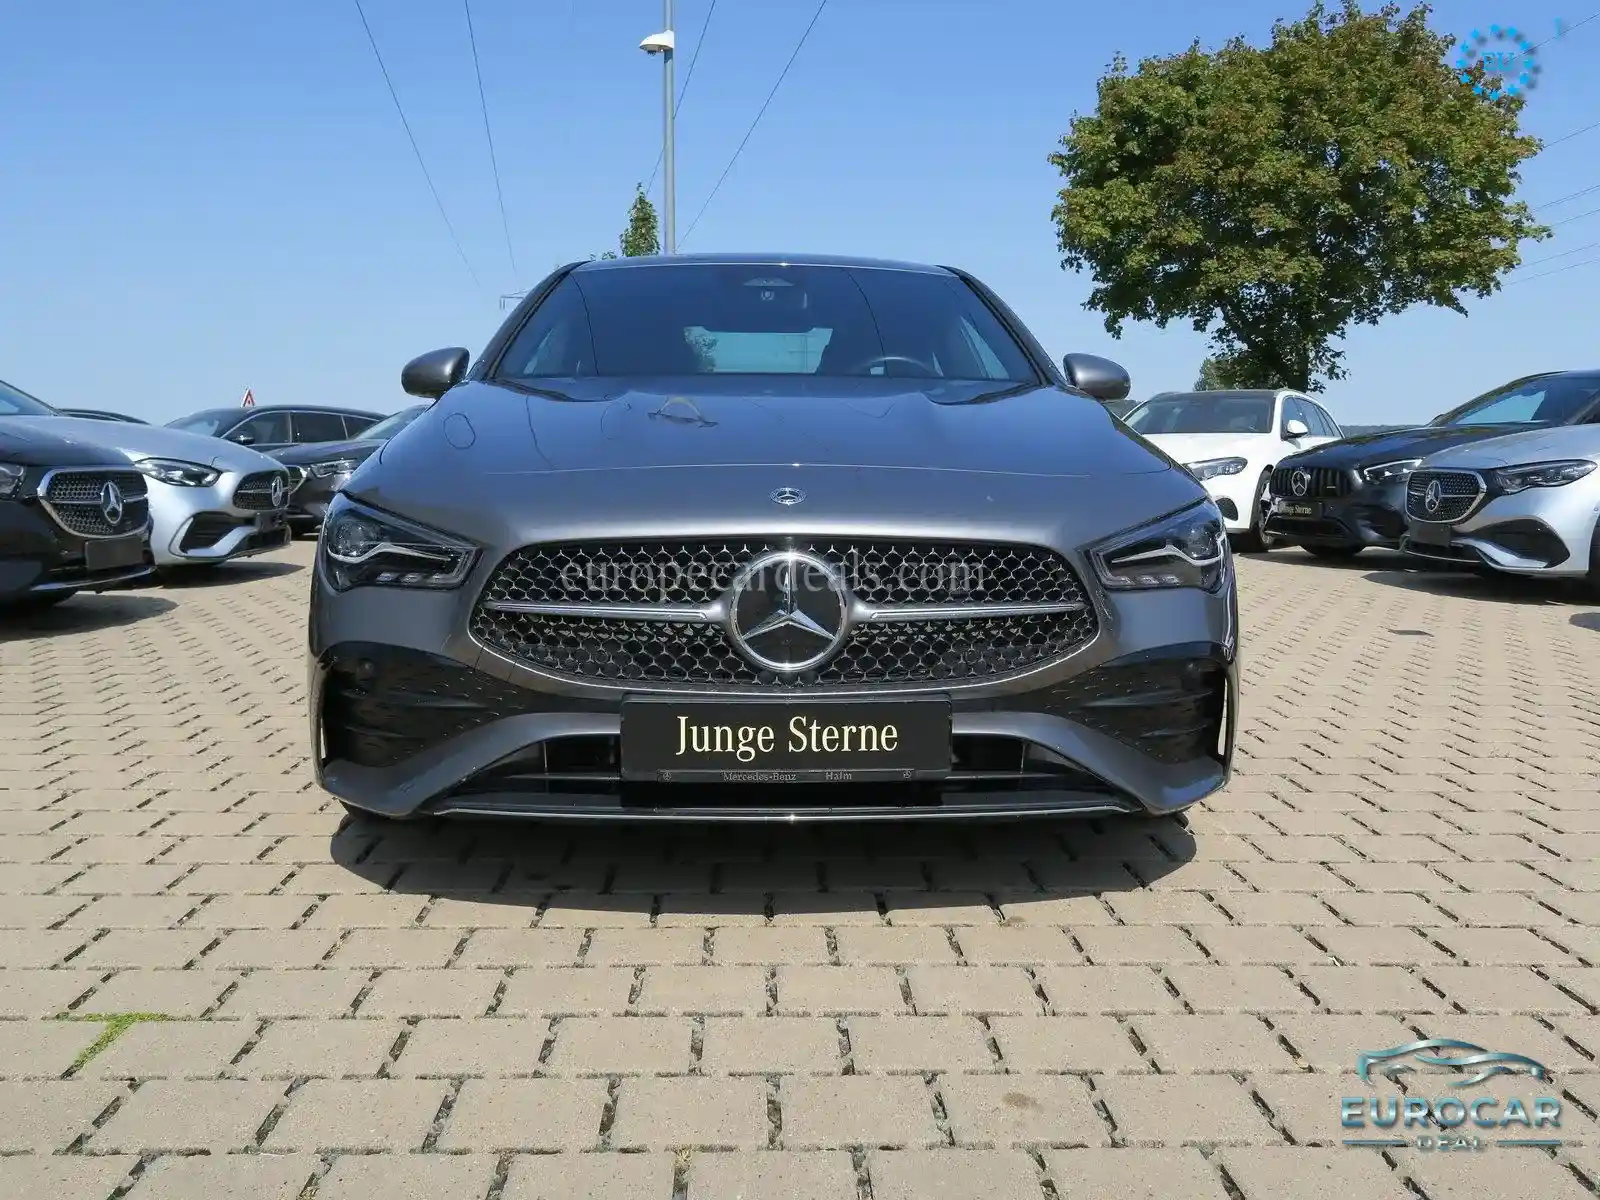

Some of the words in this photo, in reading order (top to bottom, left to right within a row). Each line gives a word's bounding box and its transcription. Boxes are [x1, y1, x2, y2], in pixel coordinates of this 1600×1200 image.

[676, 715, 775, 762] Junge
[788, 716, 899, 753] Sterne
[723, 771, 797, 781] Mercedes-Benz
